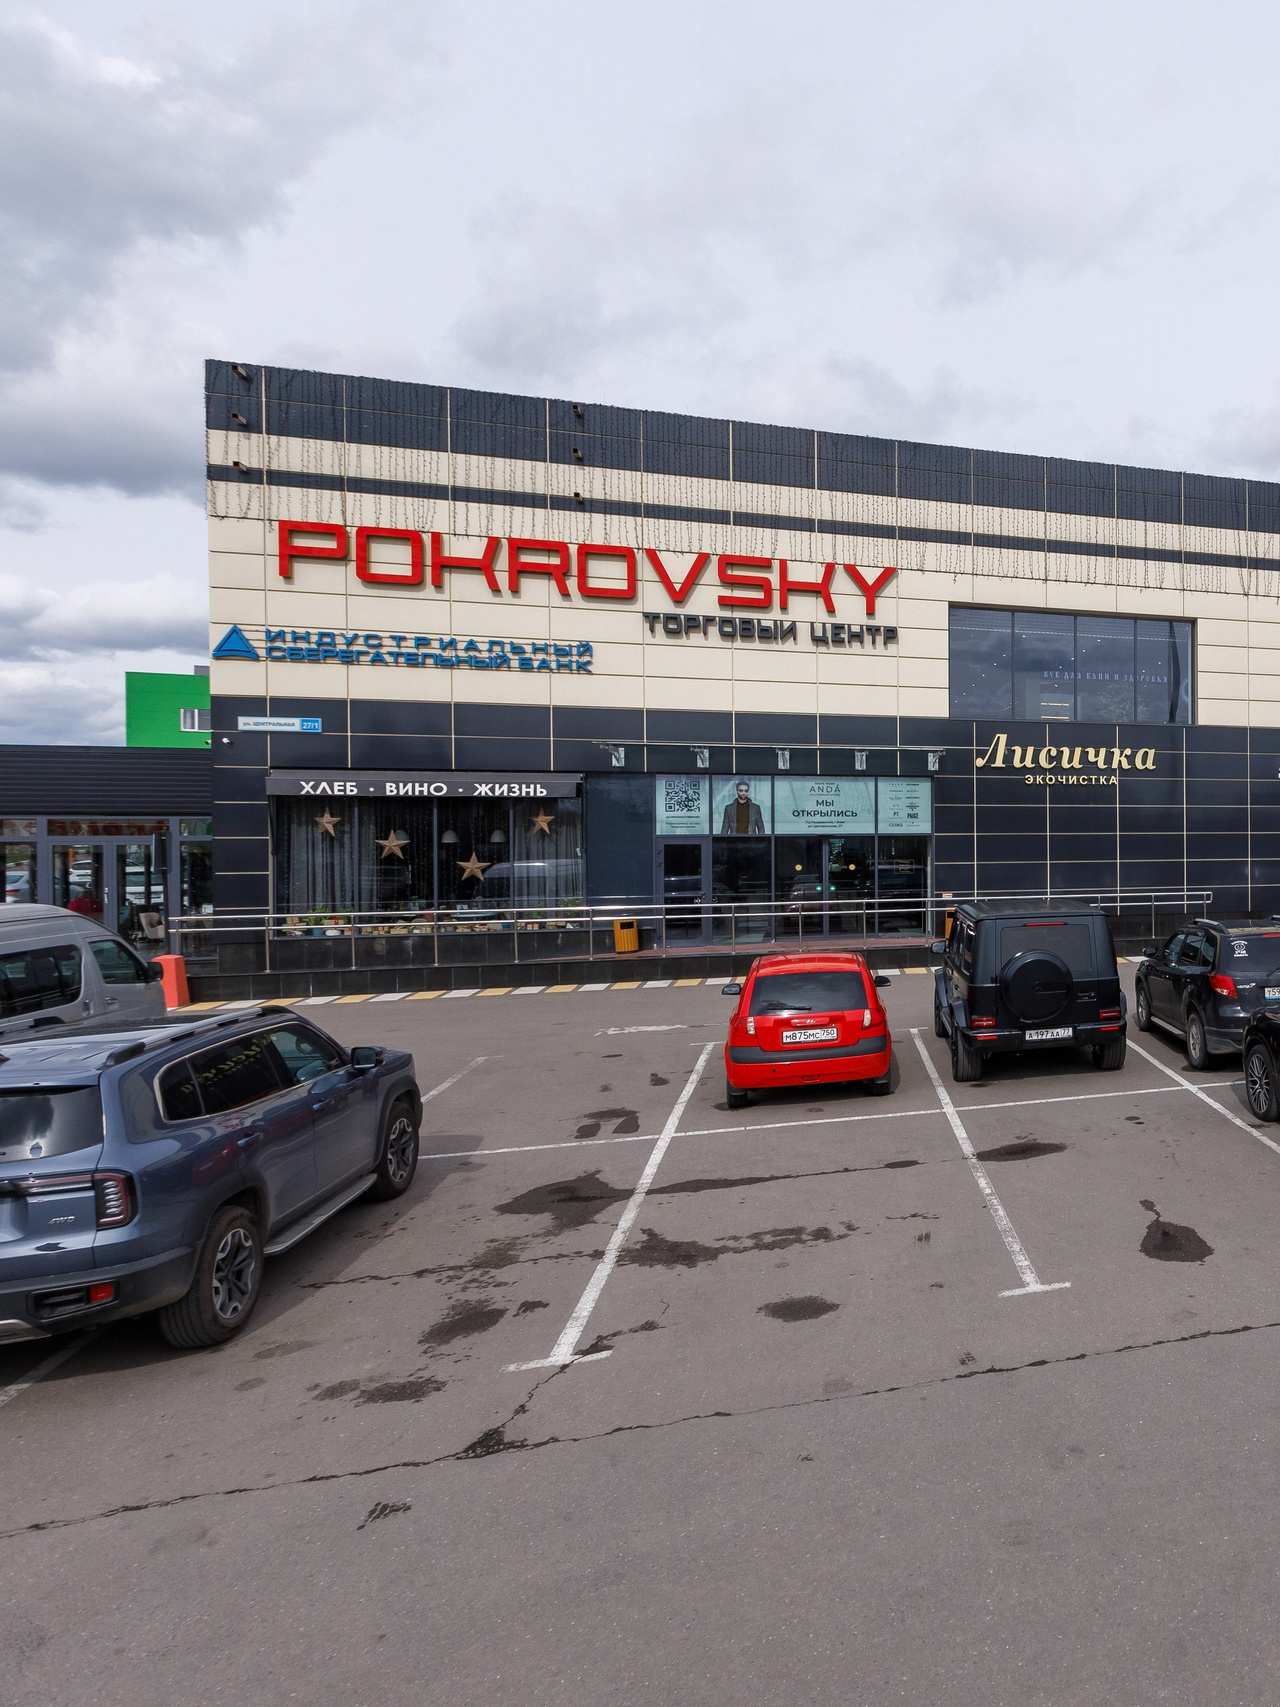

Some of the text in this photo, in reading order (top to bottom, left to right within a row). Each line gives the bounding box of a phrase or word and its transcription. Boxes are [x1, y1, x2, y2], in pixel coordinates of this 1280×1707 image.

[278, 519, 898, 615] POKROVSKY
[266, 628, 593, 658] ИНДУСТРИАЛЬНЫЙ
[810, 622, 898, 645] ЦЕНТР
[266, 645, 593, 673] СБЕРЕГАТЕЛЬНЫЙ БАНК
[975, 733, 1157, 770] Лисичка
[300, 781, 548, 797] ХЛЕБ ВИНО ЖИЗНЬ
[809, 784, 841, 793] ANDÁ
[1025, 774, 1118, 786] ЭКОЧИСТКА
[785, 1031, 820, 1041] М875МС
[1029, 1031, 1060, 1039] А197АА
